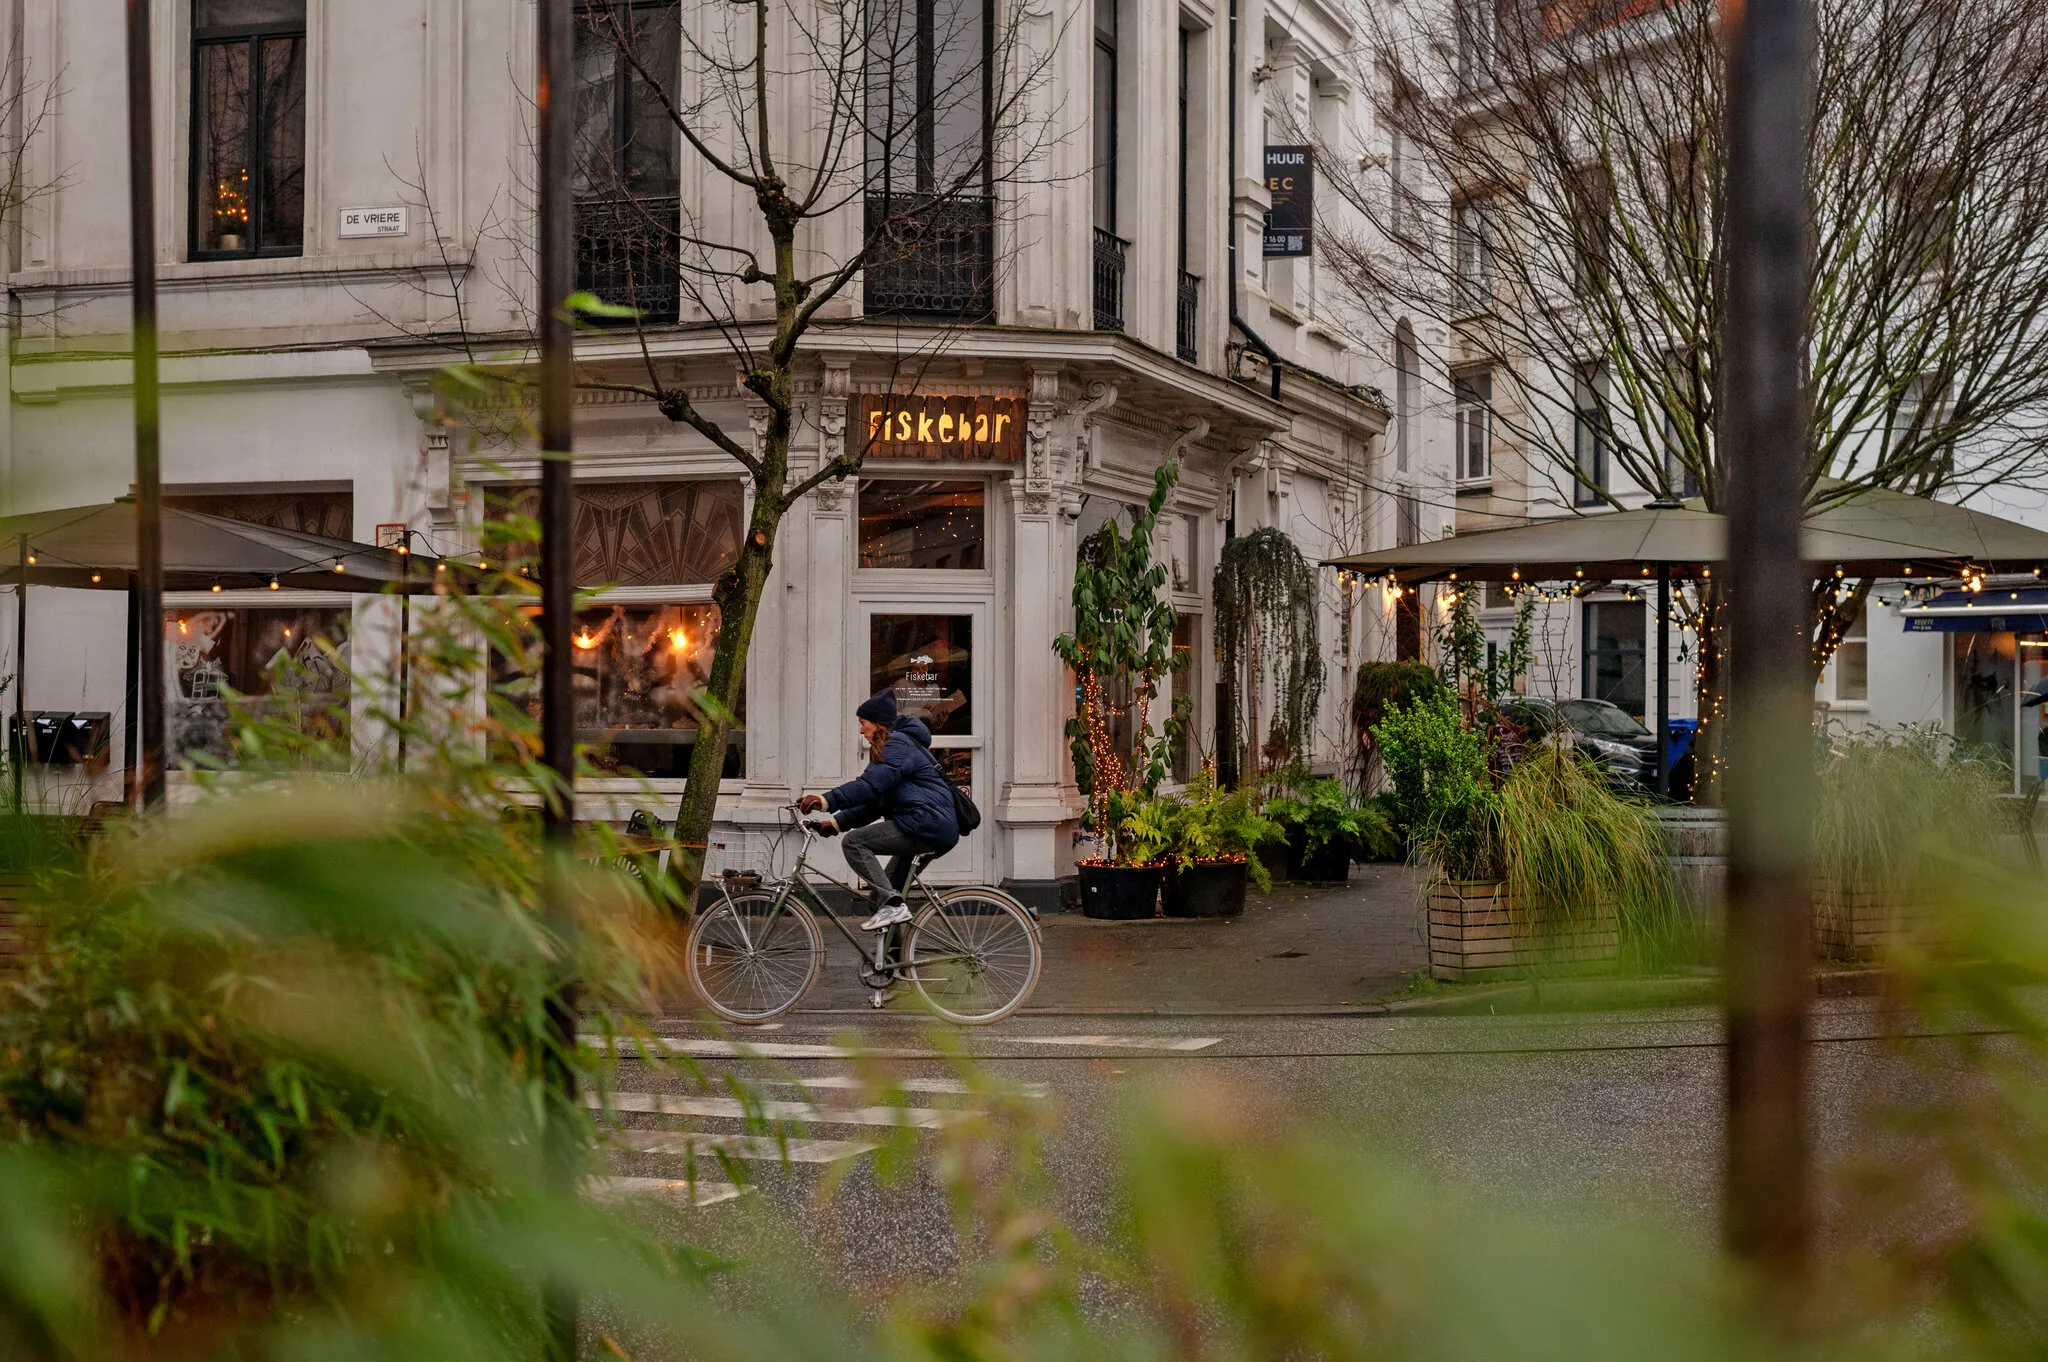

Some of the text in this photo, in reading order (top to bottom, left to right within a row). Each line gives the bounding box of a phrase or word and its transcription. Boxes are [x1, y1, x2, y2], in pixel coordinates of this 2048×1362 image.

[1267, 153, 1305, 165] HUUR
[346, 212, 400, 225] DE VRIERE
[377, 225, 400, 233] STRAAT
[905, 671, 938, 681] Fiskebar
